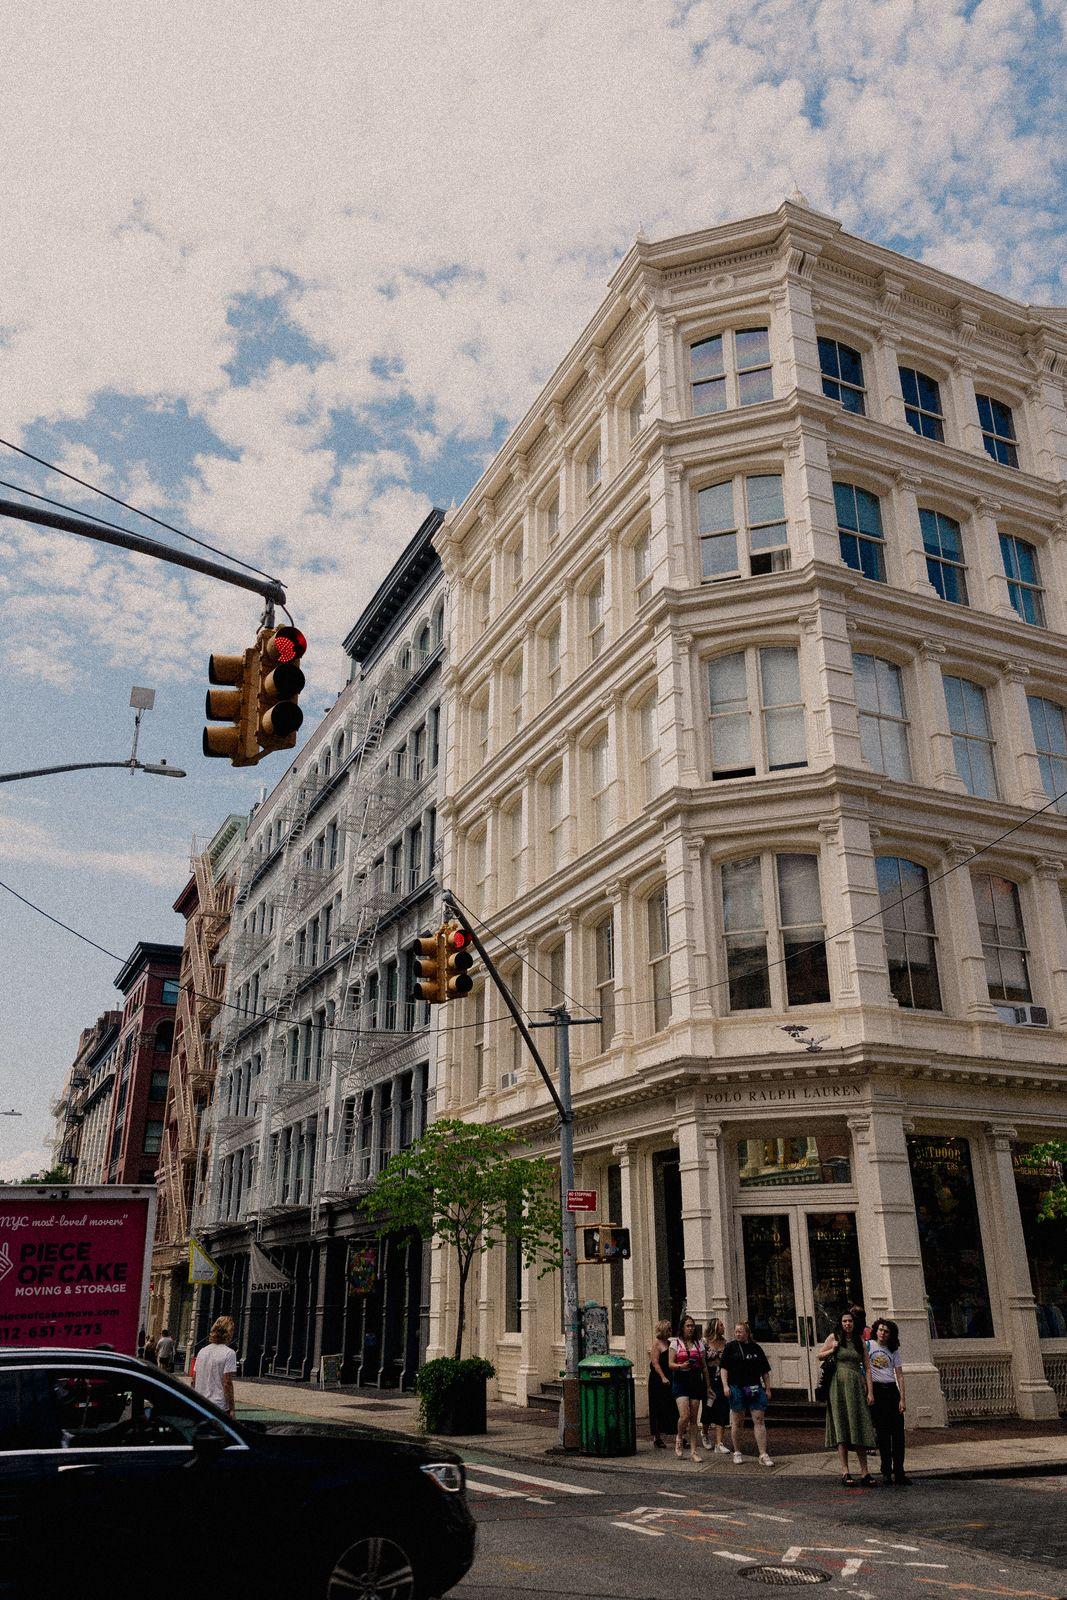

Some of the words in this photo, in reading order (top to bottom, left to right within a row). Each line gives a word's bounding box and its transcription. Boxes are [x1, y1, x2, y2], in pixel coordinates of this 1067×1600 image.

[705, 1092, 742, 1103] POLO
[750, 1089, 796, 1101] RALPH
[804, 1085, 862, 1098] LAUREN
[32, 1215, 88, 1227] most-loved
[21, 1242, 93, 1262] PIECE
[18, 1264, 55, 1284] OF
[57, 1262, 128, 1283] CAKE
[15, 1286, 61, 1297] MOVING
[64, 1285, 72, 1295] &
[75, 1284, 127, 1294] STORAGE
[251, 1282, 289, 1291] SANDRO
[0, 1323, 102, 1340] 12-651-7273
